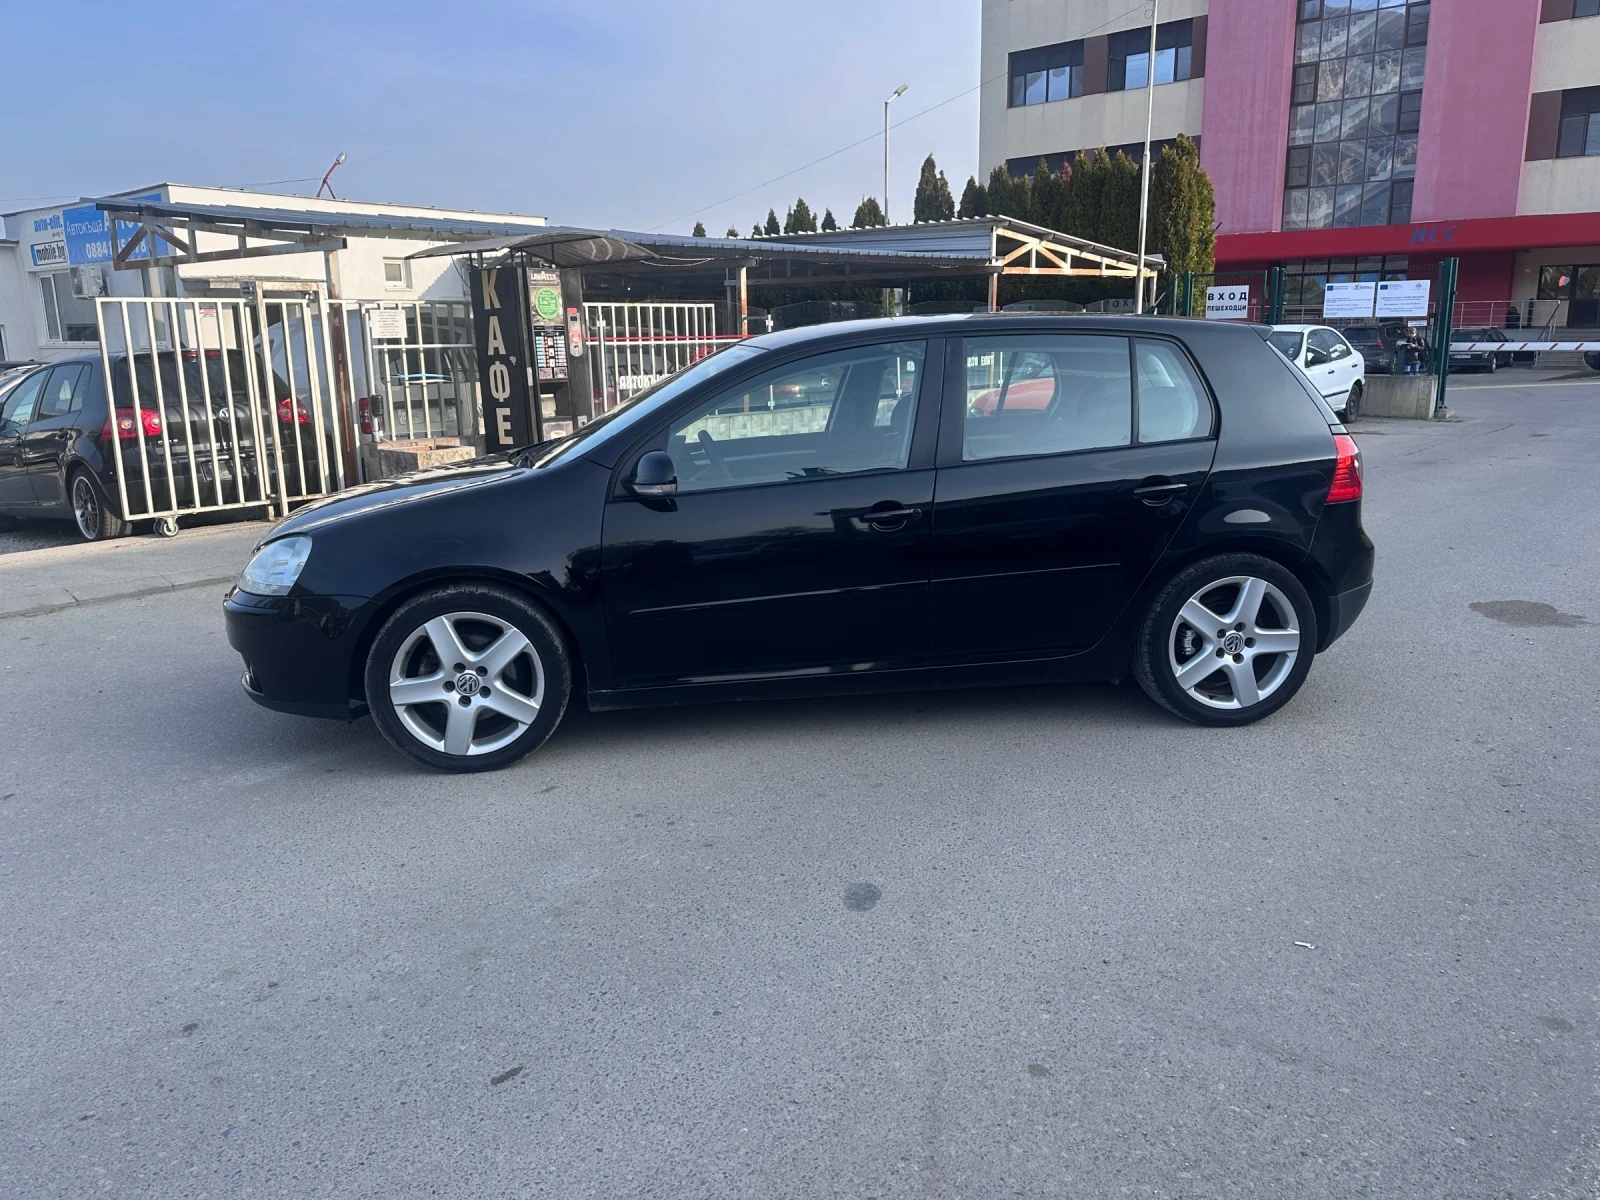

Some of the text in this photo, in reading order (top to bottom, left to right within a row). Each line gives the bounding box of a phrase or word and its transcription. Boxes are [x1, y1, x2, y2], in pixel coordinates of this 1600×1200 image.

[66, 220, 103, 236] Автокъща
[1411, 225, 1461, 244] ИСС
[36, 243, 67, 261] mobile.bg
[85, 241, 108, 258] 0884
[1207, 292, 1247, 301] ВХОД
[481, 270, 513, 445] КАФЕ
